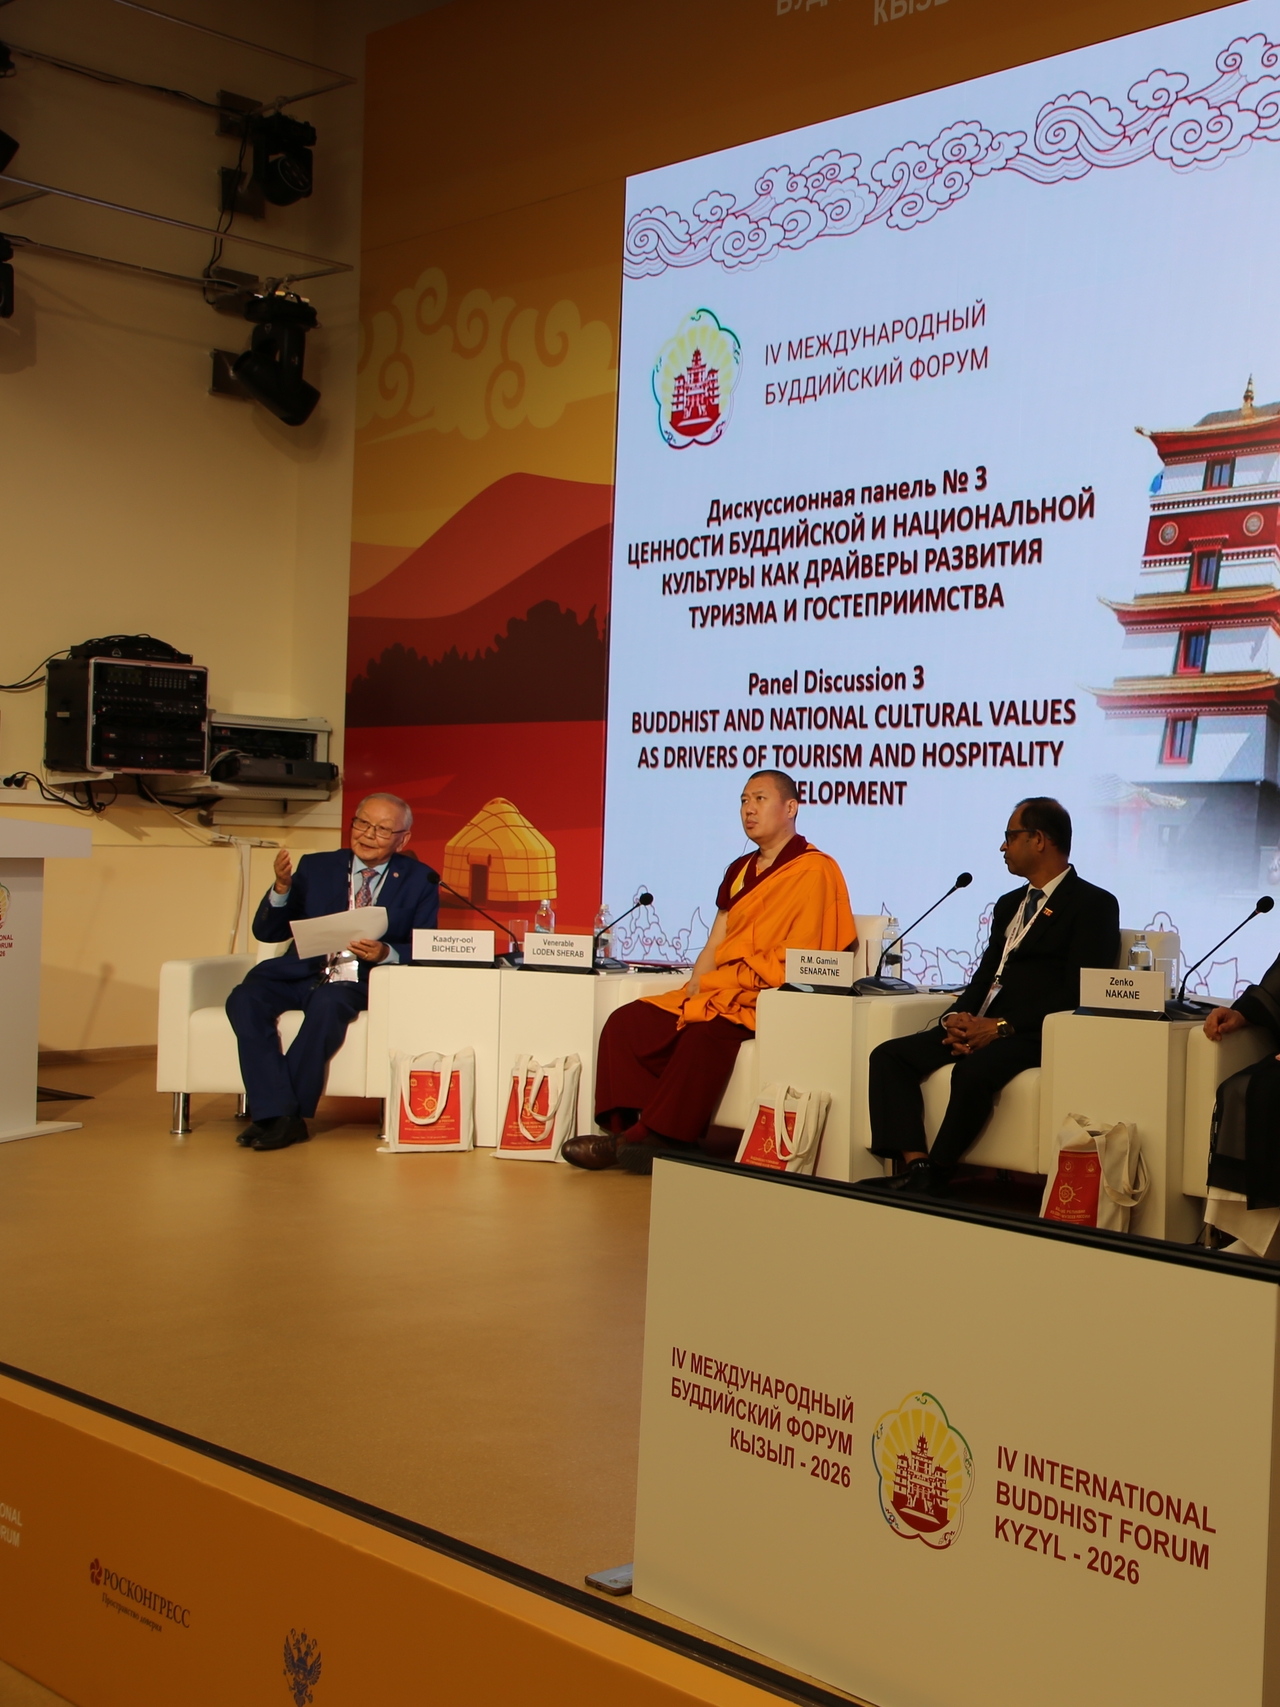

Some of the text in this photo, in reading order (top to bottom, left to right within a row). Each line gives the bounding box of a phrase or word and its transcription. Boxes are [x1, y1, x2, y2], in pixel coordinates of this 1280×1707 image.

[765, 298, 986, 366] IV МЕЖДУНАРОДНЫЙ
[765, 346, 989, 406] БУДДИЙСКИЙ ФОРУМ
[706, 465, 988, 528] Дискуссионная панель № 3
[627, 486, 1096, 569] ЦЕННОСТИ БУДДИЙСКОЙ И НАЦИОНАЛЬНОЙ
[661, 537, 1043, 596] КУЛЬТУРЫ КАК ДРАЙВЕРЫ РАЗВИТИЯ
[688, 582, 1005, 629] ТУРИЗМА И ГОСТЕПРИИМСТВА
[748, 665, 925, 696] Panel Discussion 3
[631, 698, 1077, 735] BUDDHIST AND NATIONAL CULTURAL VALUES
[637, 740, 1065, 769] AS DRIVERS OF TOURISM AND HOSPITALITY
[796, 781, 908, 806] ELOPMENT
[431, 945, 477, 954] BICHELDEY
[432, 935, 474, 945] Kaadyr-ool
[532, 948, 585, 958] LODEN SHERAB
[542, 938, 575, 948] Venerable
[800, 955, 839, 966] R.M. Gamini
[799, 966, 840, 977] SENARATNE
[1109, 976, 1134, 987] Zenko
[1105, 988, 1140, 1000] NAKANE
[671, 1346, 855, 1424] IV МЕЖДУНАРОДНЫЙ
[670, 1376, 854, 1457] БУДДИЙСКИЙ ФОРУМ
[729, 1426, 796, 1470] КЫЗЫЛ
[810, 1453, 852, 1489] 2026
[997, 1444, 1218, 1535] IV INTERNATIONAL
[0, 1525, 20, 1548] RUM
[995, 1480, 1211, 1571] BUDDHIST FORUM
[993, 1514, 1067, 1563] KYZYL
[1086, 1545, 1141, 1586] 2026
[103, 1567, 191, 1629] РОСКОНГРЕСС
